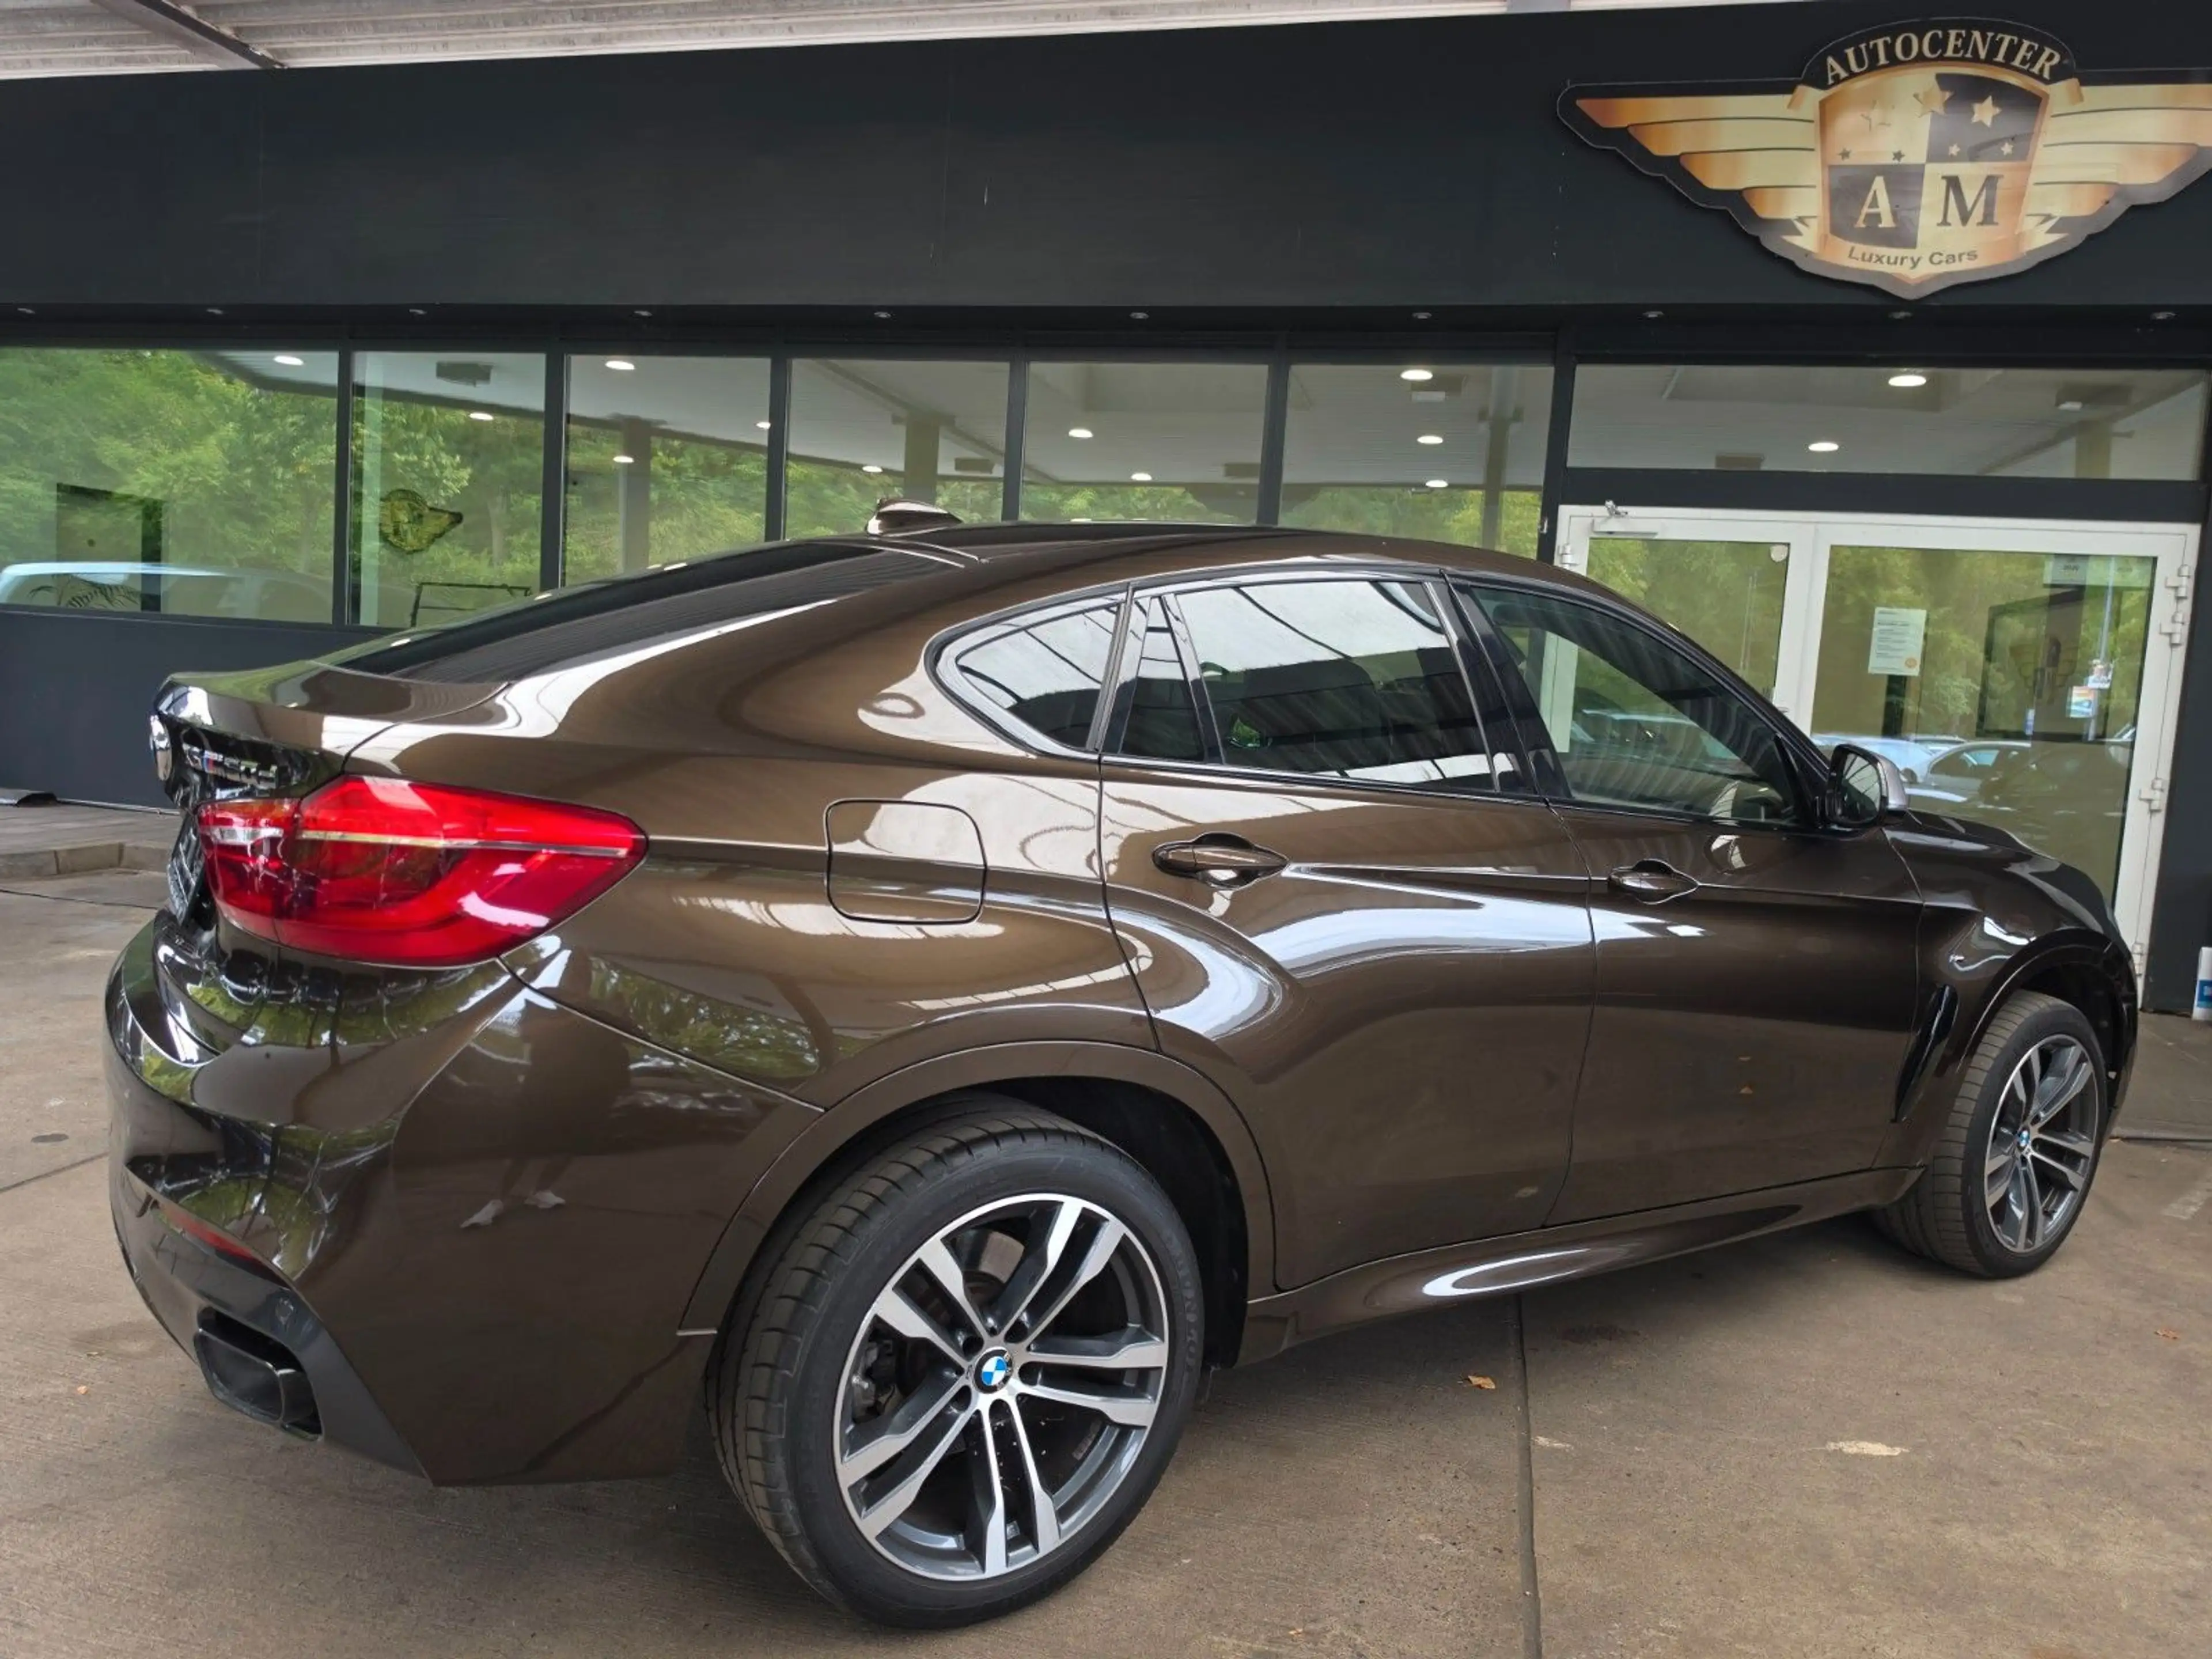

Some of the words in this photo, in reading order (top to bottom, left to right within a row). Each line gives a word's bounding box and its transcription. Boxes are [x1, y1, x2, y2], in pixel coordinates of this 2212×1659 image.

[1825, 29, 2061, 85] AUTOCENTER
[1854, 175, 1896, 228] A
[1936, 174, 2004, 227] M
[1847, 246, 1922, 270] Luxury
[1929, 250, 1978, 266] Cars
